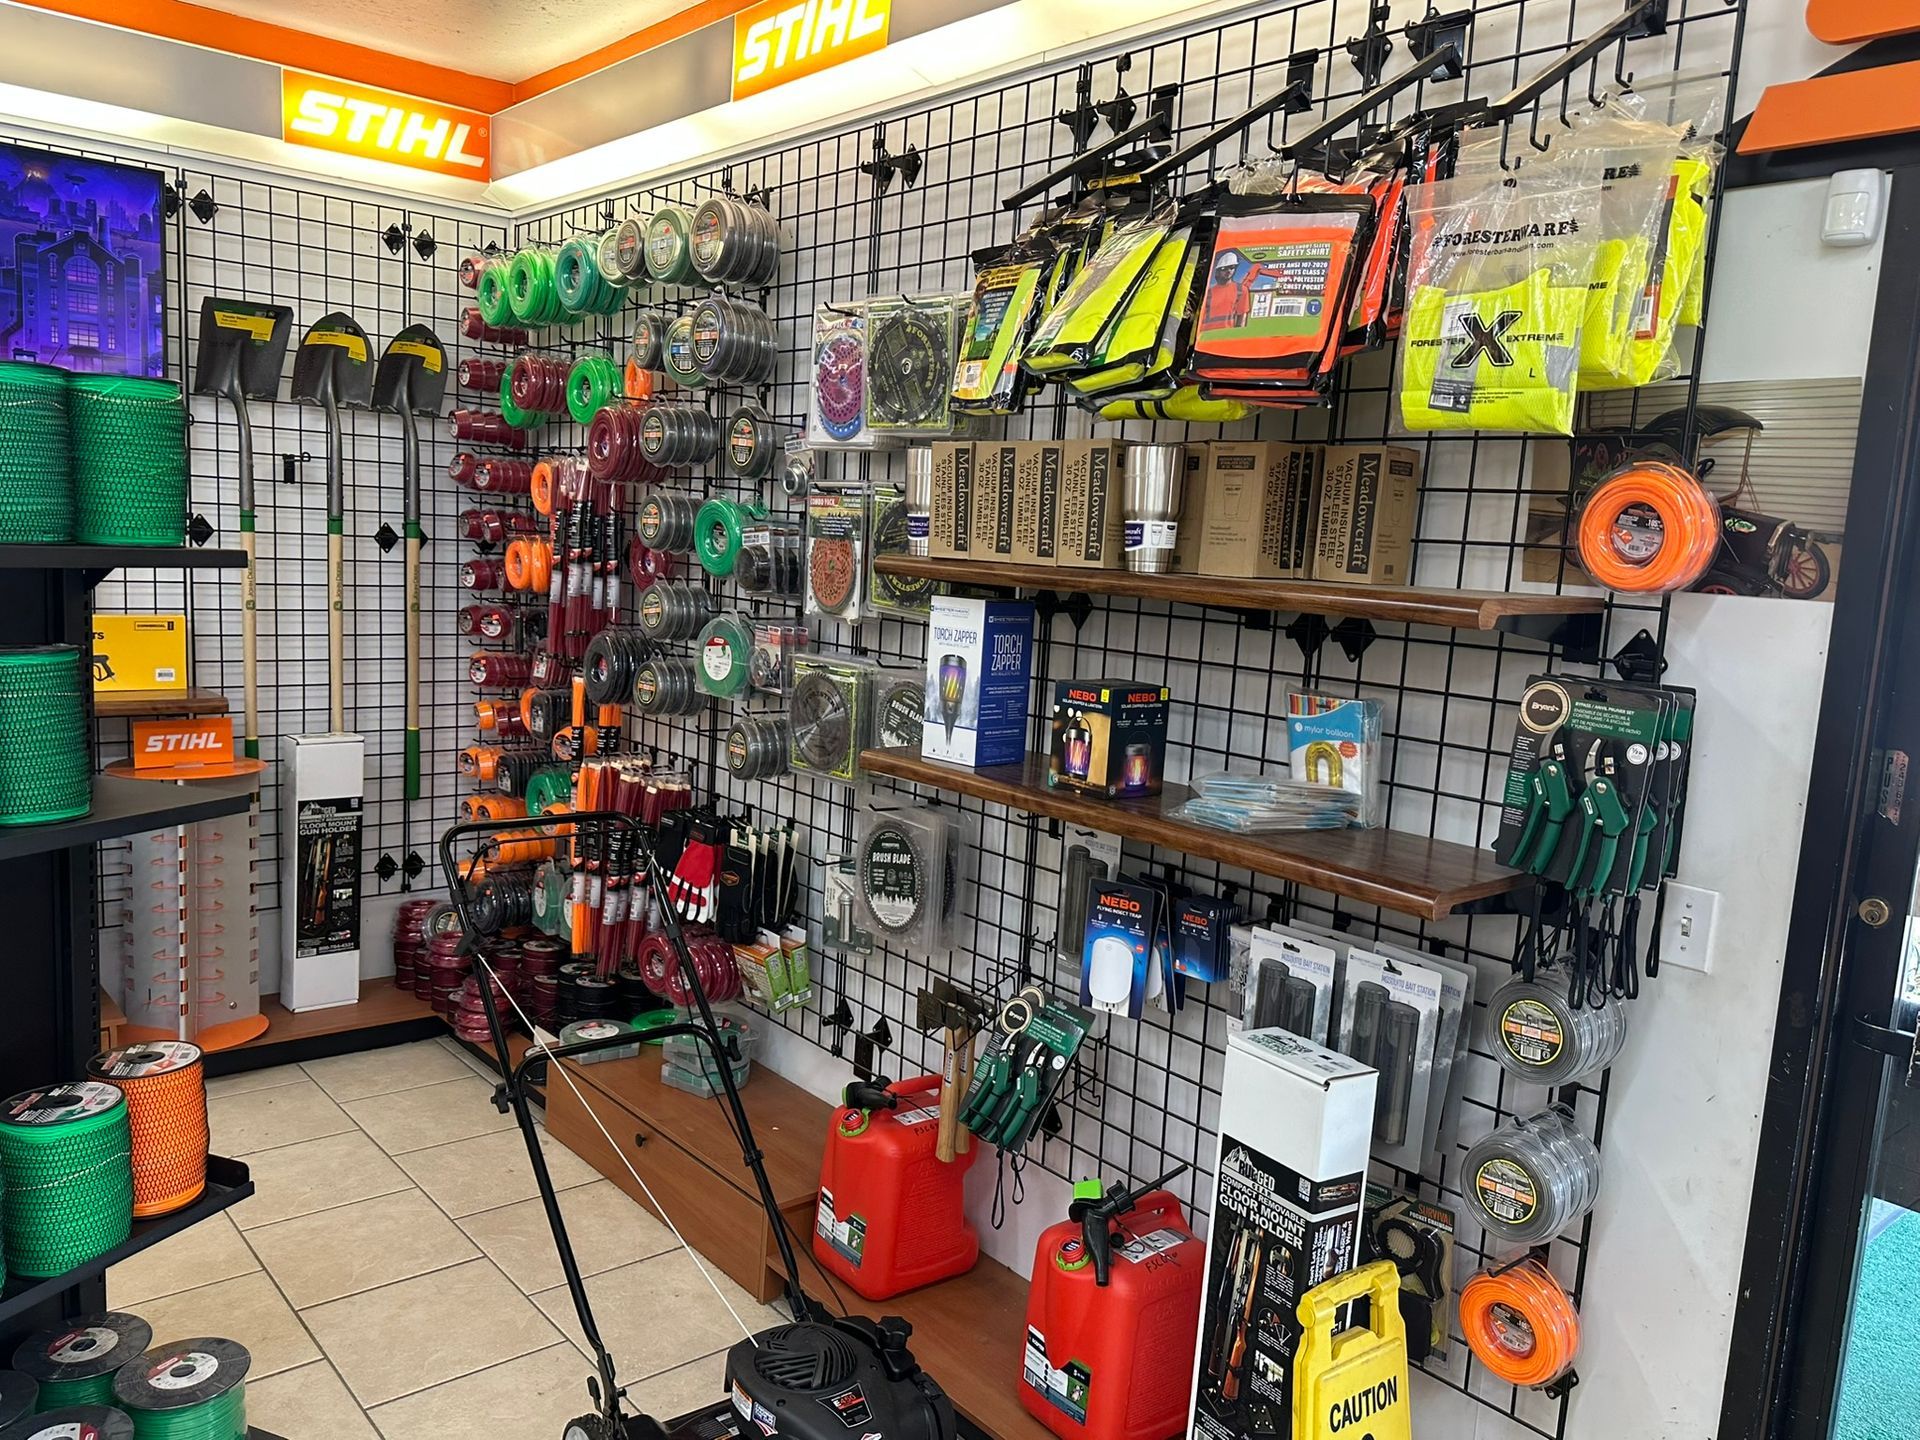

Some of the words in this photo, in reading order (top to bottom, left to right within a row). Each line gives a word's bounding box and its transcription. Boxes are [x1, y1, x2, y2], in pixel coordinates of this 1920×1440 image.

[737, 0, 885, 82] STIHL
[290, 89, 484, 168] STIHL
[1443, 221, 1570, 247] FORESTERWARE
[1277, 249, 1305, 257] SAFETY
[1306, 248, 1330, 256] SHIRT
[1451, 310, 1522, 368] X
[1506, 332, 1565, 343] EXTREME
[1529, 367, 1536, 378] L
[935, 463, 940, 473] 30
[979, 463, 984, 473] 30
[1019, 463, 1026, 474] 30
[1031, 452, 1040, 497] VACUUM
[1066, 464, 1073, 475] 30
[1078, 453, 1088, 498] VACUUM
[1327, 470, 1334, 481] 30
[1343, 458, 1355, 505] VACUUM
[822, 497, 835, 507] PACK
[957, 453, 969, 545] Meadowcraft
[999, 453, 1014, 548] Meadowcraft
[1040, 453, 1056, 552] Meadowcraft
[1089, 453, 1106, 555] Meadowcraft
[987, 496, 996, 550] INSULATED
[1061, 497, 1070, 547] TUMBLER
[1352, 459, 1378, 568] Meadowcraft
[981, 514, 989, 543] STEEL
[1029, 499, 1037, 553] INSULATED
[1068, 516, 1076, 550] STEEL
[1075, 501, 1085, 557] INSULATED
[1319, 505, 1331, 557] TUMBLER
[1327, 528, 1337, 561] STEEL
[1335, 508, 1349, 569] INSULATED
[934, 626, 953, 641] TORCH
[953, 629, 978, 645] ZAPPER
[993, 634, 1023, 655] TORCH
[991, 653, 1022, 672] ZAPPER
[1068, 689, 1097, 702] NEBO
[1127, 693, 1157, 703] NEBO
[891, 700, 909, 716] BRUSH
[1532, 702, 1556, 711] Bryant
[145, 732, 222, 752] STIHL
[1304, 725, 1323, 734] mylar
[1325, 728, 1354, 739] balloon
[300, 822, 327, 830] FLOOR
[328, 820, 357, 828] MOUNT
[300, 828, 319, 836] GUN
[320, 825, 357, 834] HOLDER
[872, 852, 891, 864] BRUSH
[892, 852, 911, 865] BLADE
[1097, 905, 1113, 914] FLYING
[1112, 908, 1129, 916] INSECT
[1129, 911, 1142, 919] TRAP
[1100, 894, 1140, 912] NEBO
[1183, 913, 1208, 926] NEBO
[1281, 953, 1302, 966] MOSQUITO
[1302, 959, 1313, 968] BAIT
[1313, 961, 1331, 974] STATION
[1405, 981, 1416, 991] BAIT
[1416, 984, 1437, 997] STATION
[1441, 984, 1461, 998] STATION
[1220, 1182, 1258, 1212] FLOOR
[1260, 1205, 1305, 1237] MOUNT
[1221, 1174, 1257, 1199] COMPACT
[1258, 1196, 1306, 1227] REMOVABLE
[1219, 1193, 1247, 1217] GUN
[1250, 1212, 1303, 1251] HOLDER
[1409, 1211, 1427, 1223] POCKET
[1418, 1204, 1453, 1226] SURVIVAL
[1330, 1376, 1398, 1433] CAUTION
